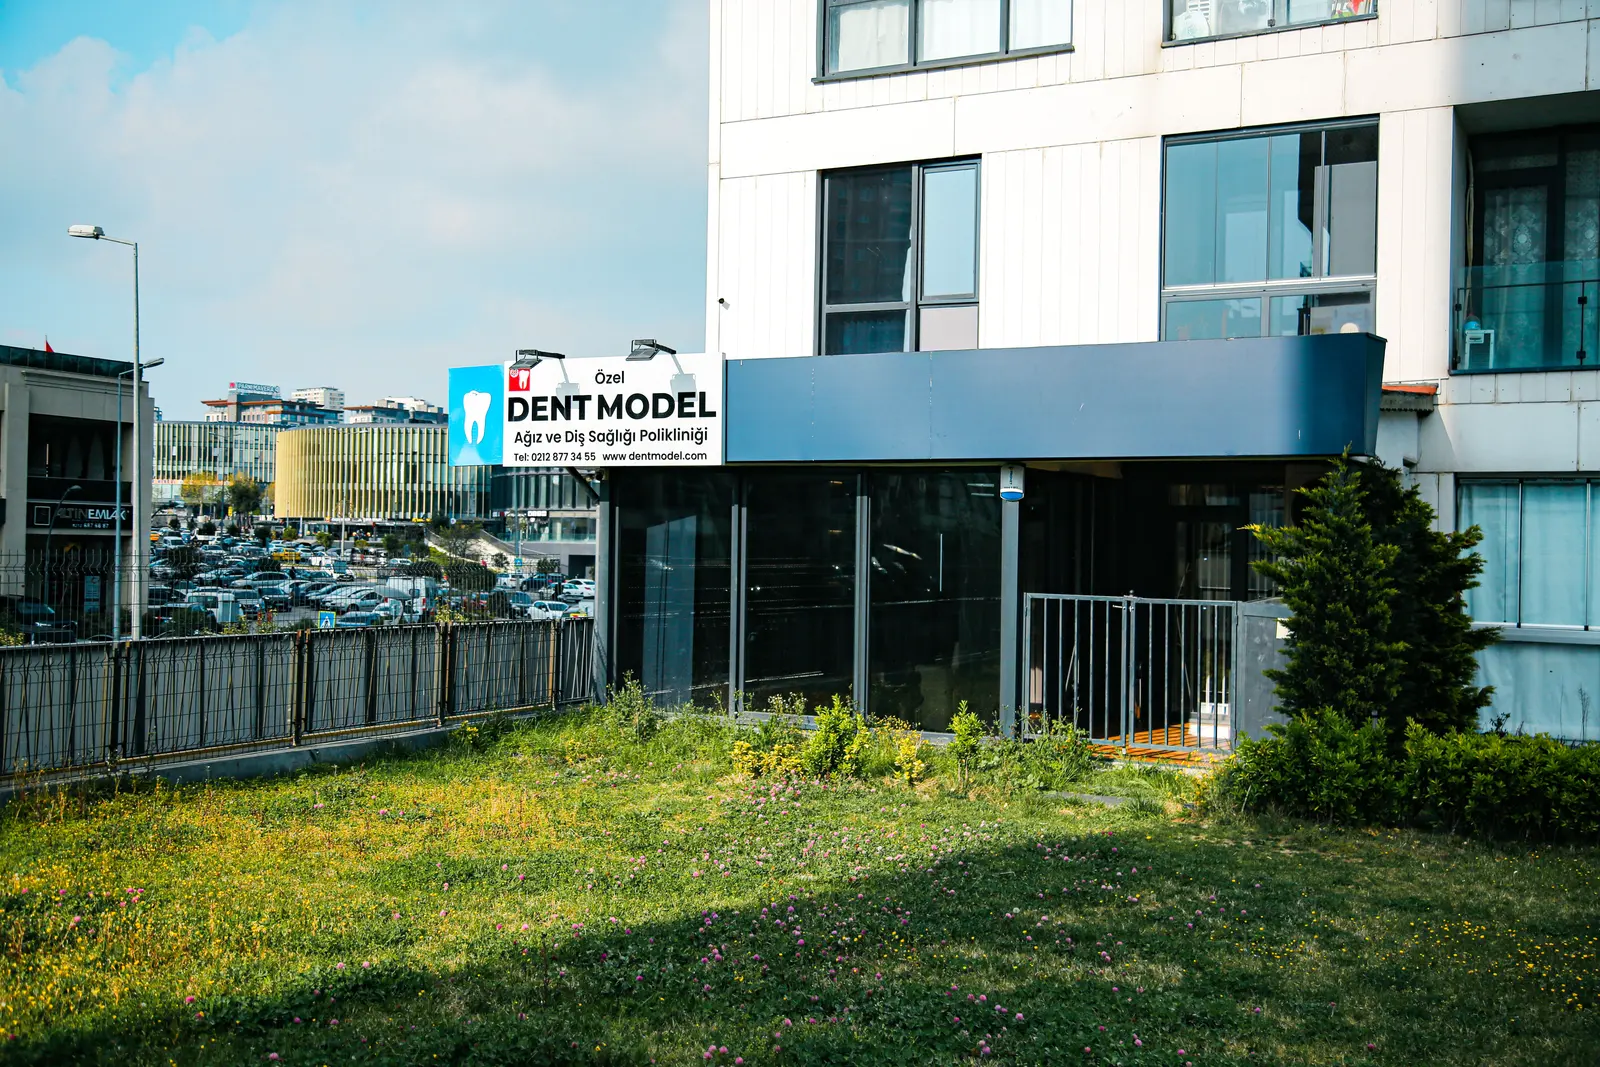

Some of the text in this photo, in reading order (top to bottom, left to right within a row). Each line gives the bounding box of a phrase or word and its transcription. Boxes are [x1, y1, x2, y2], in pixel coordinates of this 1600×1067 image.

[595, 369, 624, 384] Özel
[508, 392, 716, 421] DENT MODEL
[514, 427, 707, 447] Ağız ve Diş Sağlığı Polikliniği
[514, 453, 529, 461] Tel:
[531, 453, 550, 461] 0212
[553, 452, 568, 461] 877
[571, 452, 582, 461] 34
[585, 452, 596, 461] 55
